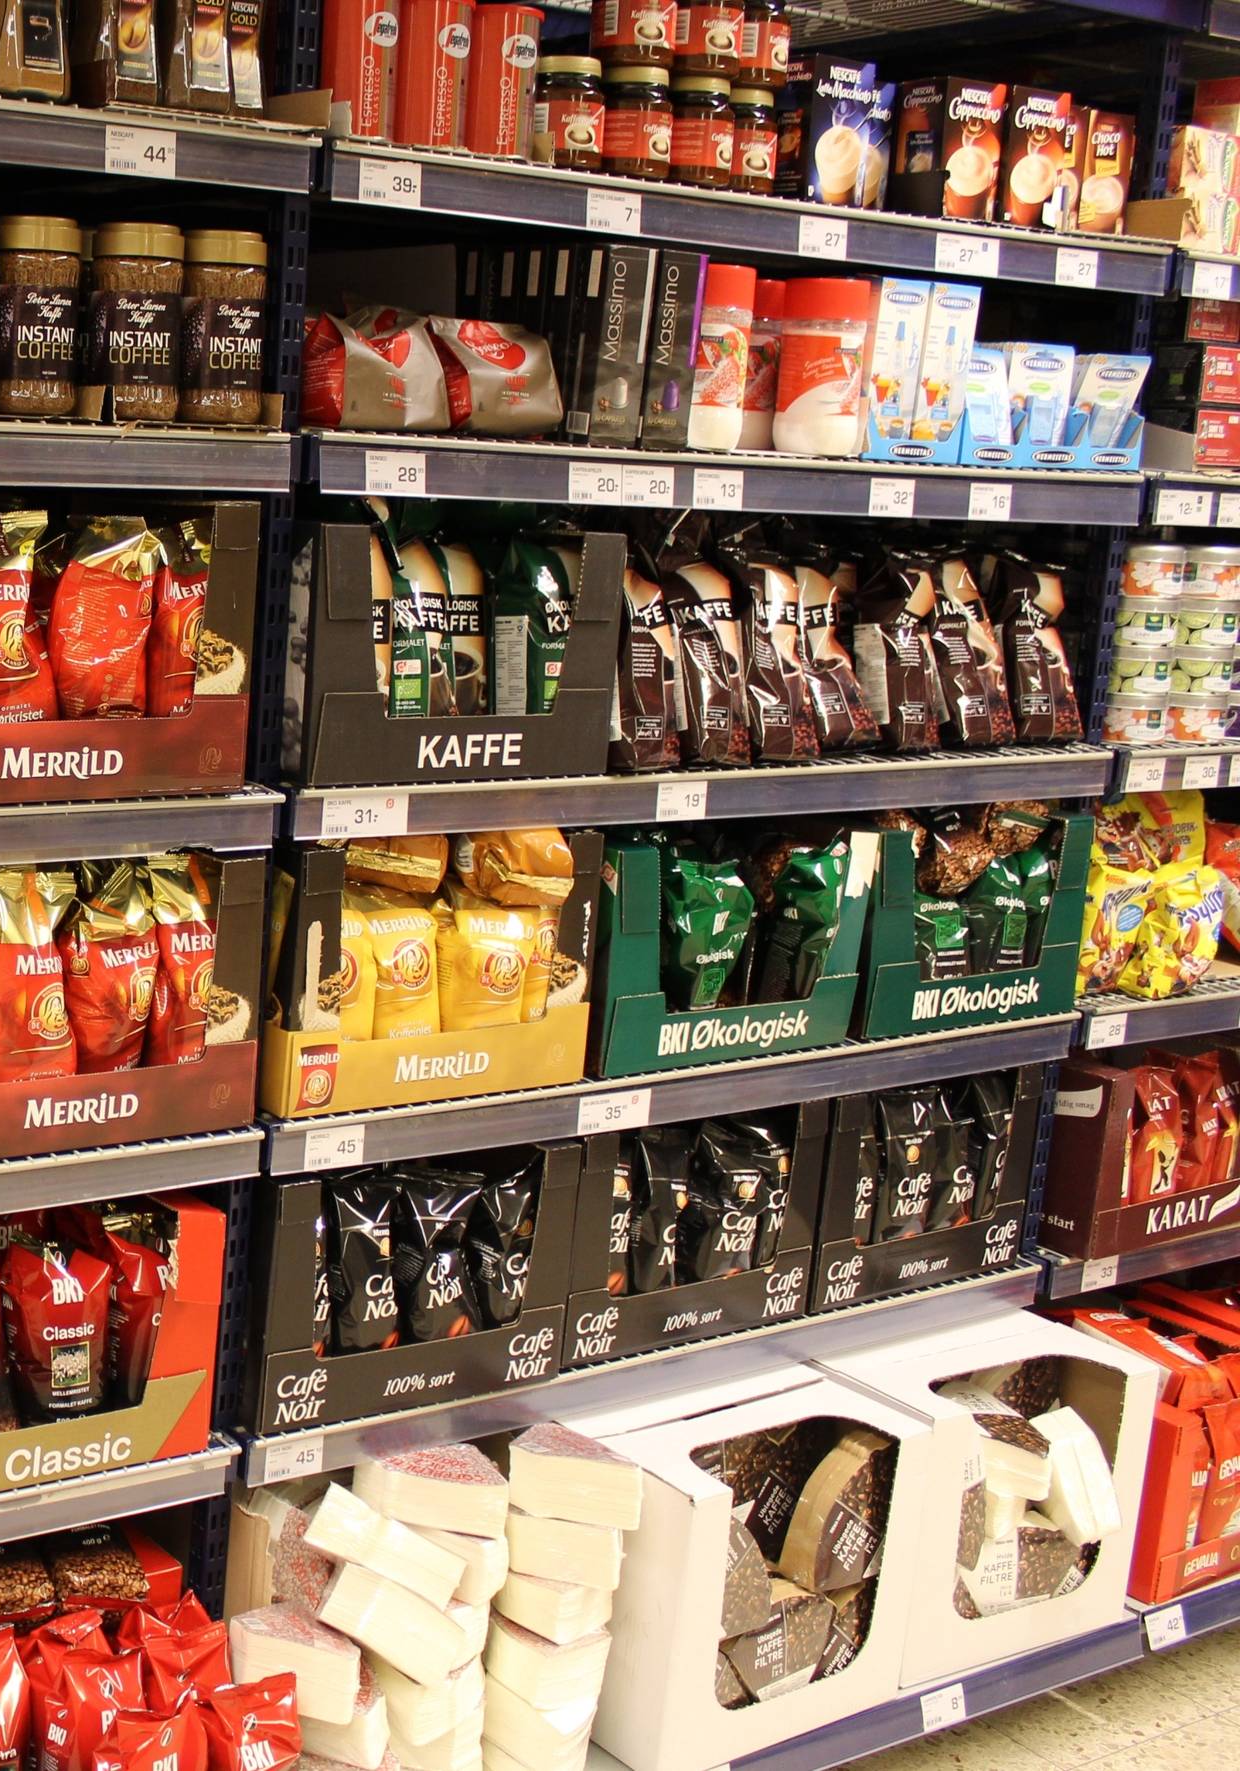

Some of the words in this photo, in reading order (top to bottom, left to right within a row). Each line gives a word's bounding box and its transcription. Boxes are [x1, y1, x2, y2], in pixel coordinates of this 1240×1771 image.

[230, 12, 257, 27] GOLD
[360, 56, 375, 128] ESPRESSO
[433, 66, 448, 137] ESPRESSO
[496, 76, 511, 146] ESPRESSO
[949, 97, 1001, 123] Cappuccino
[1015, 105, 1066, 132] Cappuccino
[1091, 131, 1120, 144] Choco
[1096, 143, 1115, 157] Hot
[143, 145, 167, 164] 44
[603, 261, 626, 362] Massimo
[656, 265, 679, 366] Massimo
[17, 326, 75, 343] INSTANT
[109, 331, 171, 348] INSTANT
[210, 337, 262, 354] INSTANT
[17, 341, 73, 361] COFFEE
[109, 346, 170, 365] COFFEE
[209, 352, 260, 370] COFFEE
[398, 466, 417, 484] 28
[720, 483, 736, 498] 13
[416, 732, 523, 769] KAFFE
[685, 793, 700, 808] 19
[712, 910, 730, 935] BKI
[912, 986, 939, 1021] BKI
[940, 976, 1040, 1017] Økologisk
[658, 1019, 688, 1057] BKI
[691, 1009, 809, 1052] Økologisk
[605, 1105, 622, 1121] 35
[337, 1139, 357, 1154] 45
[897, 1174, 932, 1200] Café
[893, 1198, 929, 1219] Noir
[1145, 1194, 1210, 1235] KARAT
[985, 1219, 1017, 1246] Café
[1047, 1213, 1076, 1231] start
[899, 1260, 929, 1280] 100%
[930, 1256, 949, 1273] sort
[982, 1244, 1015, 1268] Noir
[764, 1268, 804, 1296] Café
[827, 1256, 864, 1284] Café
[52, 1278, 84, 1306] BKI
[823, 1281, 860, 1306] Noir
[762, 1293, 801, 1319] Noir
[42, 1322, 95, 1341] Classic
[575, 1307, 619, 1337] Café
[663, 1311, 698, 1334] 100%
[699, 1308, 722, 1324] sort
[509, 1328, 554, 1357] Café
[572, 1334, 616, 1361] Noir
[505, 1354, 552, 1382] Noir
[52, 1387, 90, 1397] MELLEMRISTET
[277, 1369, 328, 1401] Café
[382, 1373, 426, 1398] 100%
[428, 1370, 456, 1389] sort
[273, 1398, 325, 1425] Noir
[5, 1432, 132, 1483] Classic
[296, 1448, 315, 1464] 45
[767, 1495, 794, 1535] FILTRE
[843, 1529, 869, 1571] FILTRE
[1184, 1551, 1219, 1577] GEVALIA
[980, 1572, 1013, 1585] FILTRE
[1167, 1616, 1180, 1631] 42
[754, 1649, 784, 1670] FILTRE
[48, 1722, 67, 1746] BKI
[241, 1741, 274, 1769] BKI
